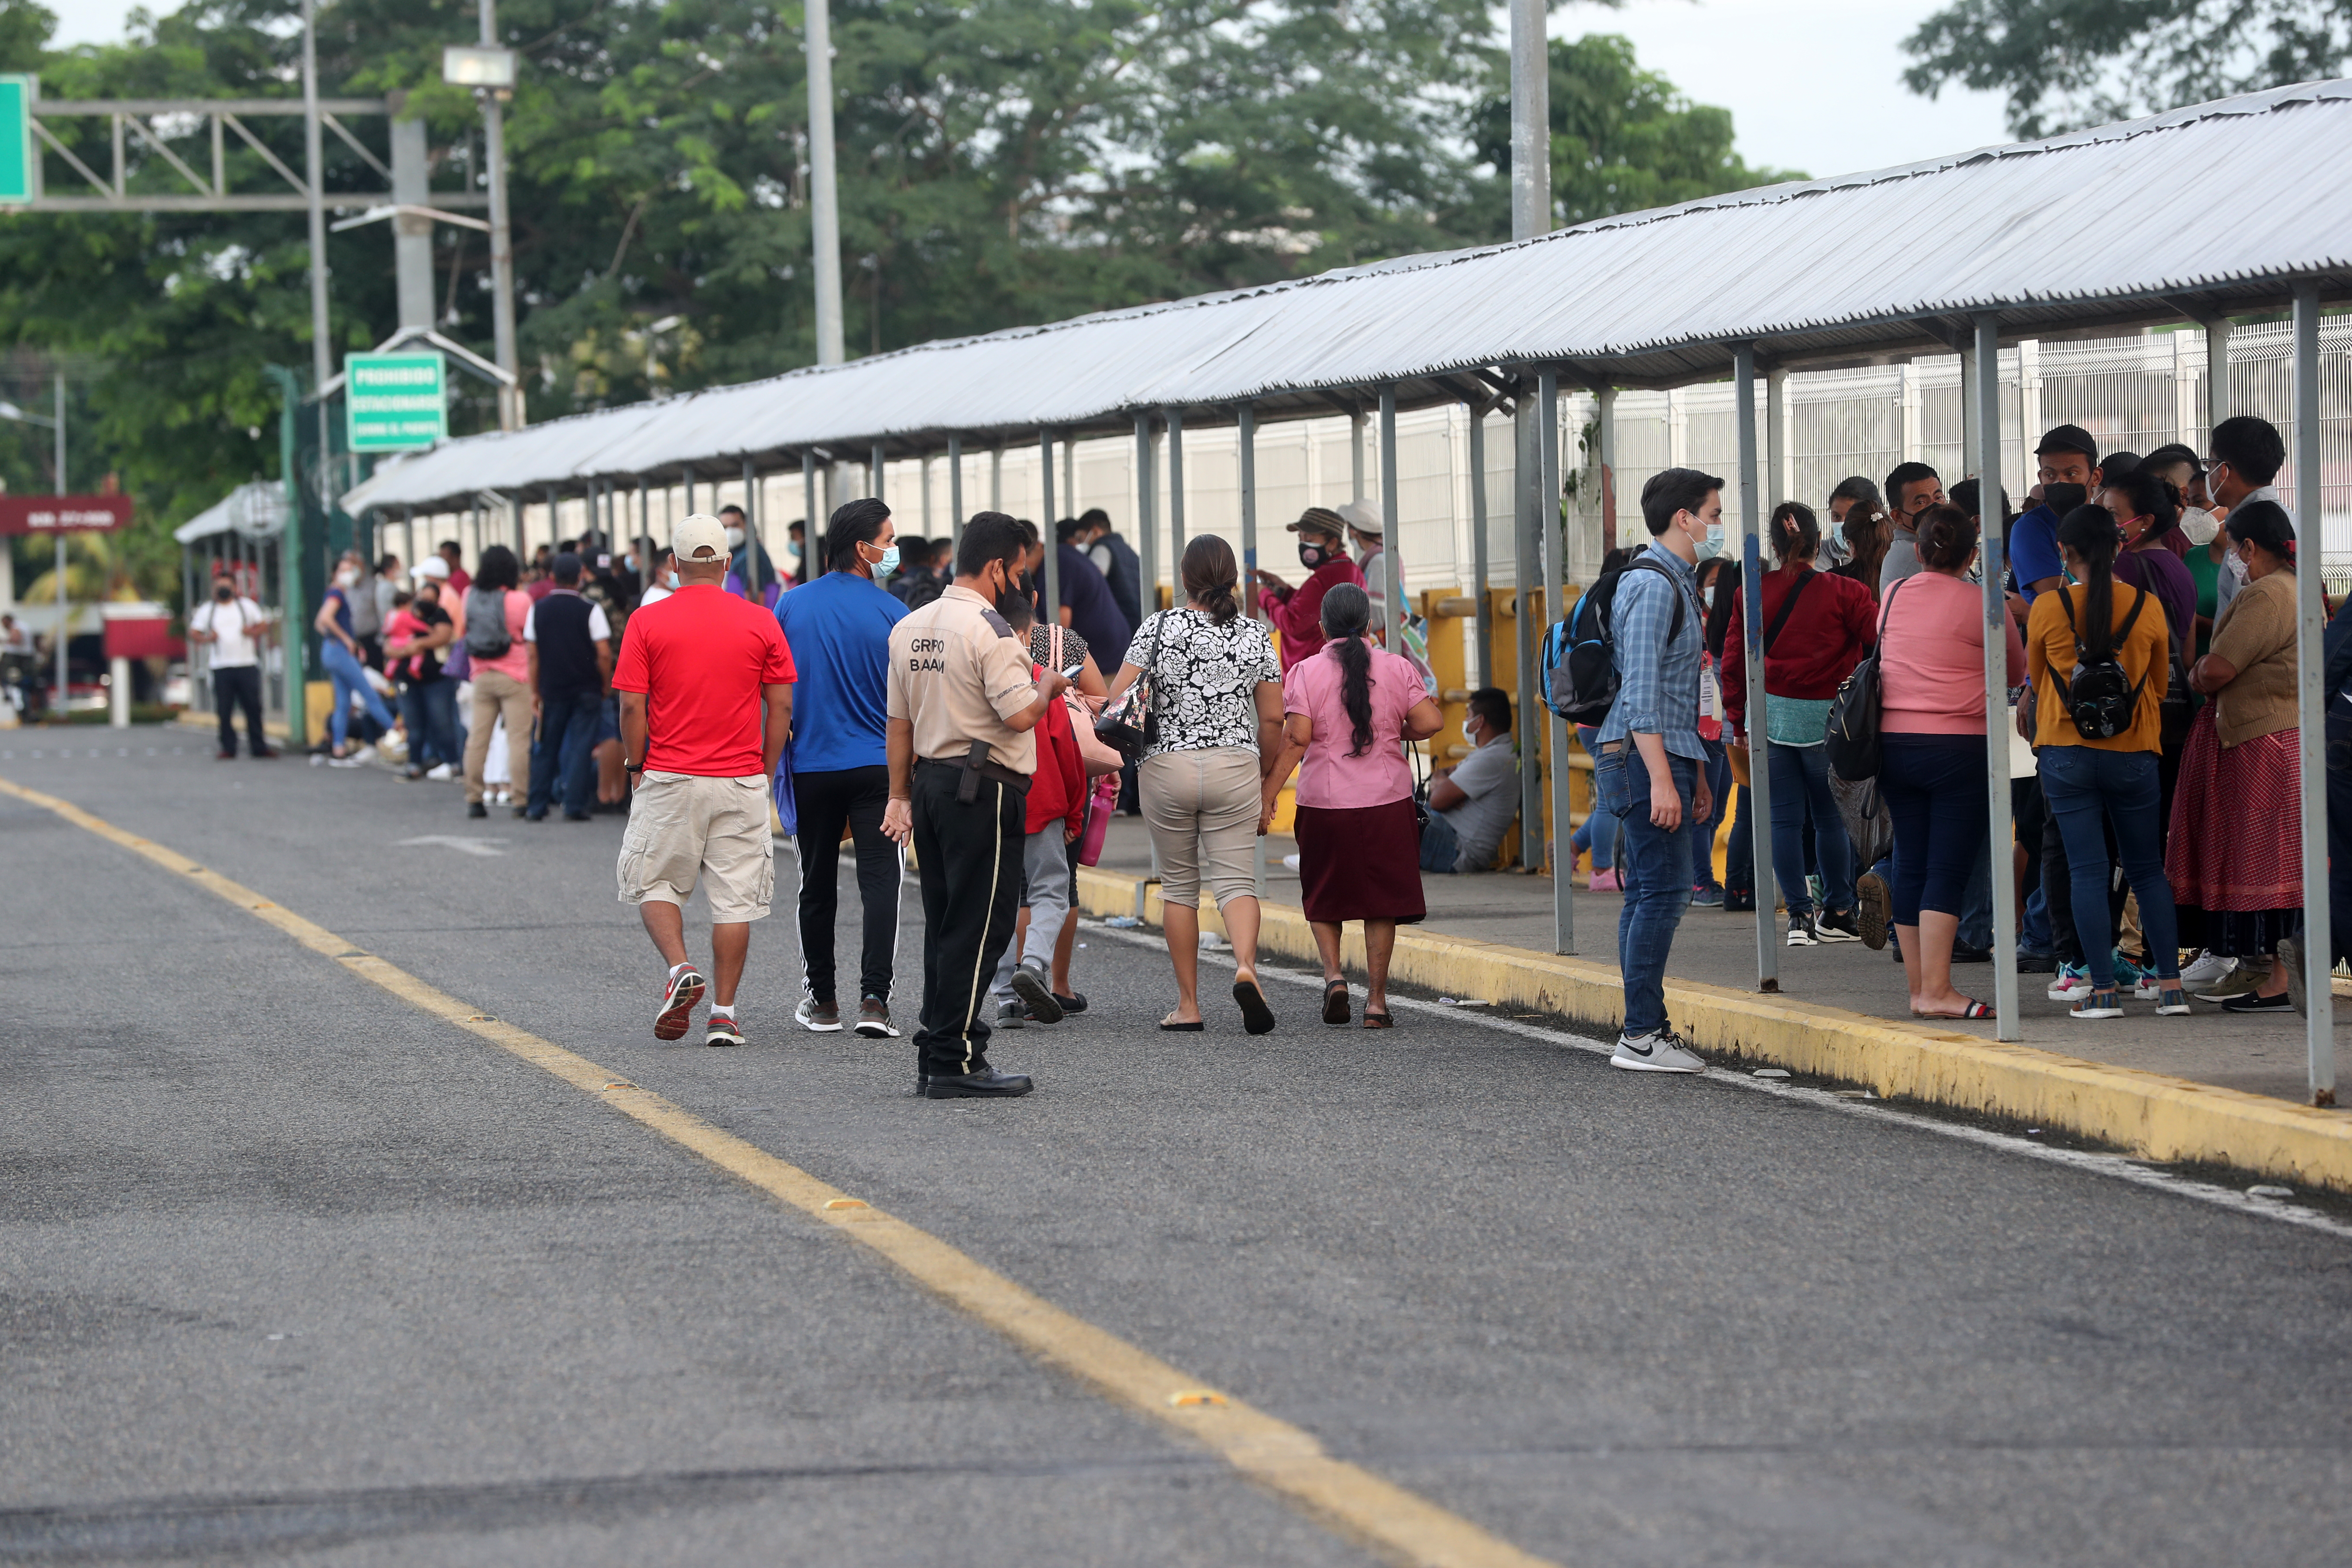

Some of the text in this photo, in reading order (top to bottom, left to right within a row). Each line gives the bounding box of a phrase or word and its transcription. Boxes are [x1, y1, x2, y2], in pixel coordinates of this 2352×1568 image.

[356, 368, 436, 385] PROHIBIDO
[352, 395, 441, 412] ESTACIONARSE
[997, 687, 1013, 700] SEGURIDAD
